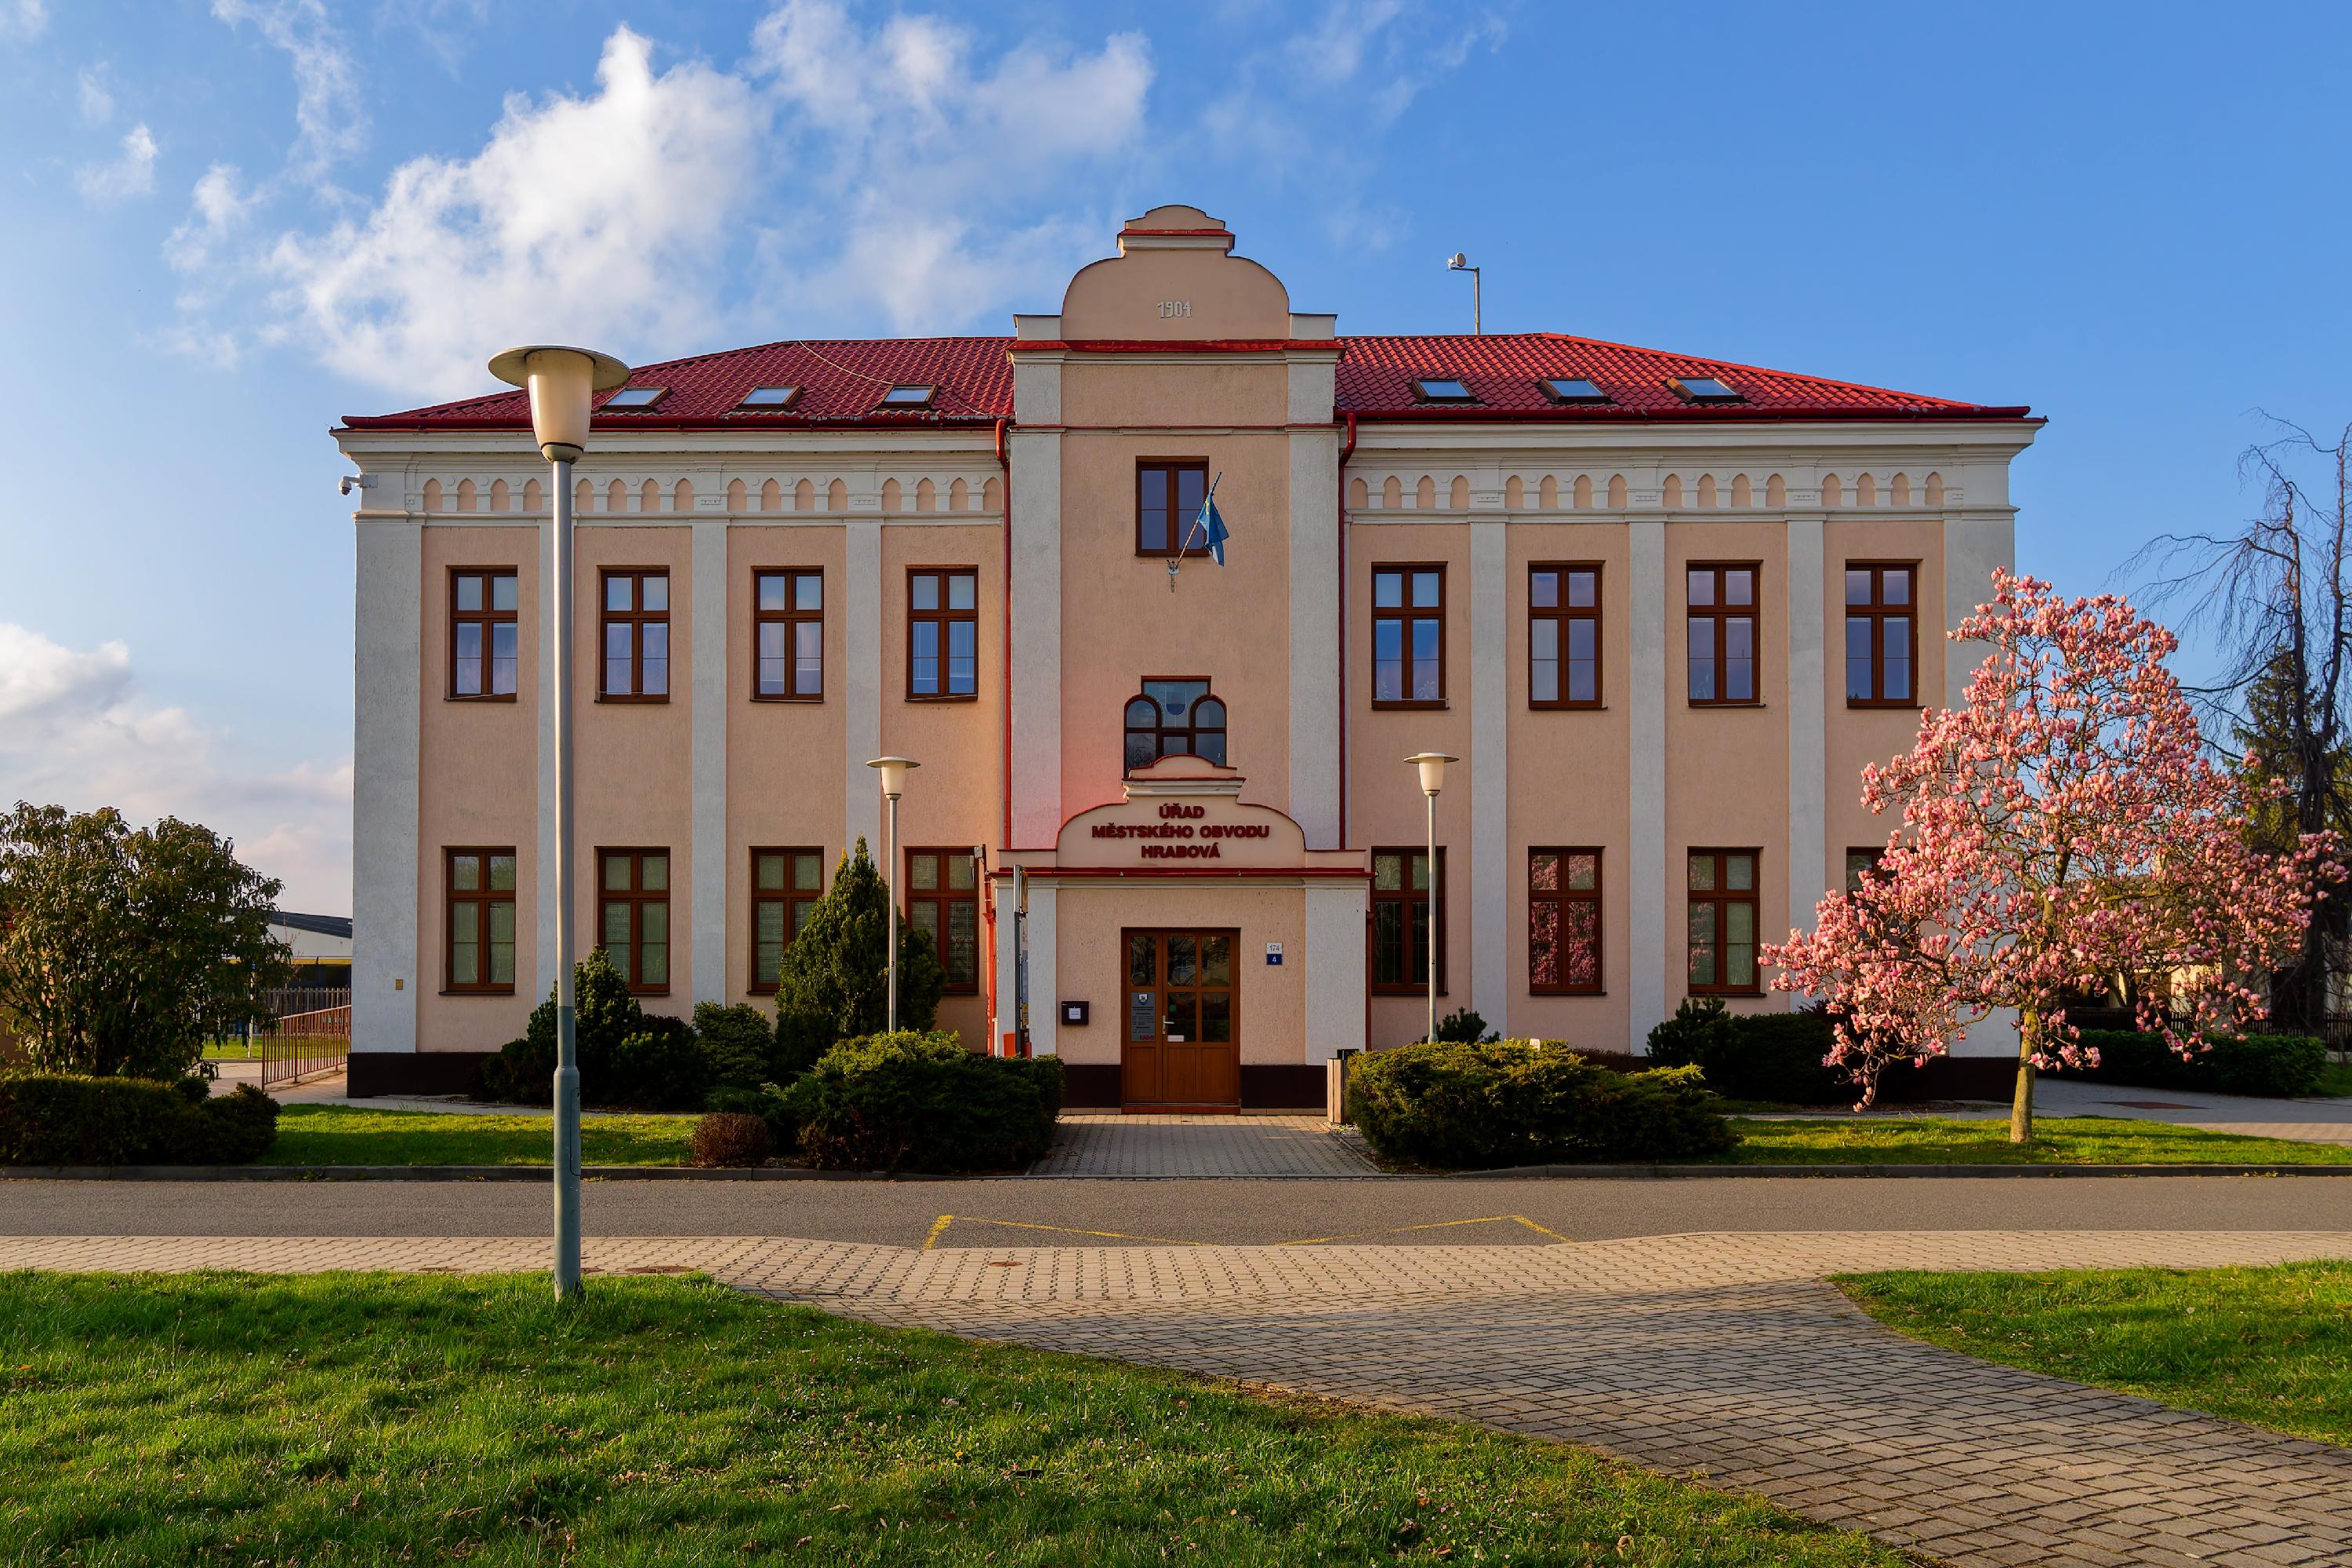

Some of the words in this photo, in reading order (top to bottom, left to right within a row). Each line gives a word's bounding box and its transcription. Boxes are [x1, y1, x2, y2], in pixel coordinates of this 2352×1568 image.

[1157, 300, 1192, 318] 1904
[1159, 803, 1205, 819] ÚŘAD
[1091, 822, 1194, 838] MĚSTSKÉHO
[1200, 826, 1269, 838] OBVODU
[1141, 842, 1221, 858] HRABOVÁ
